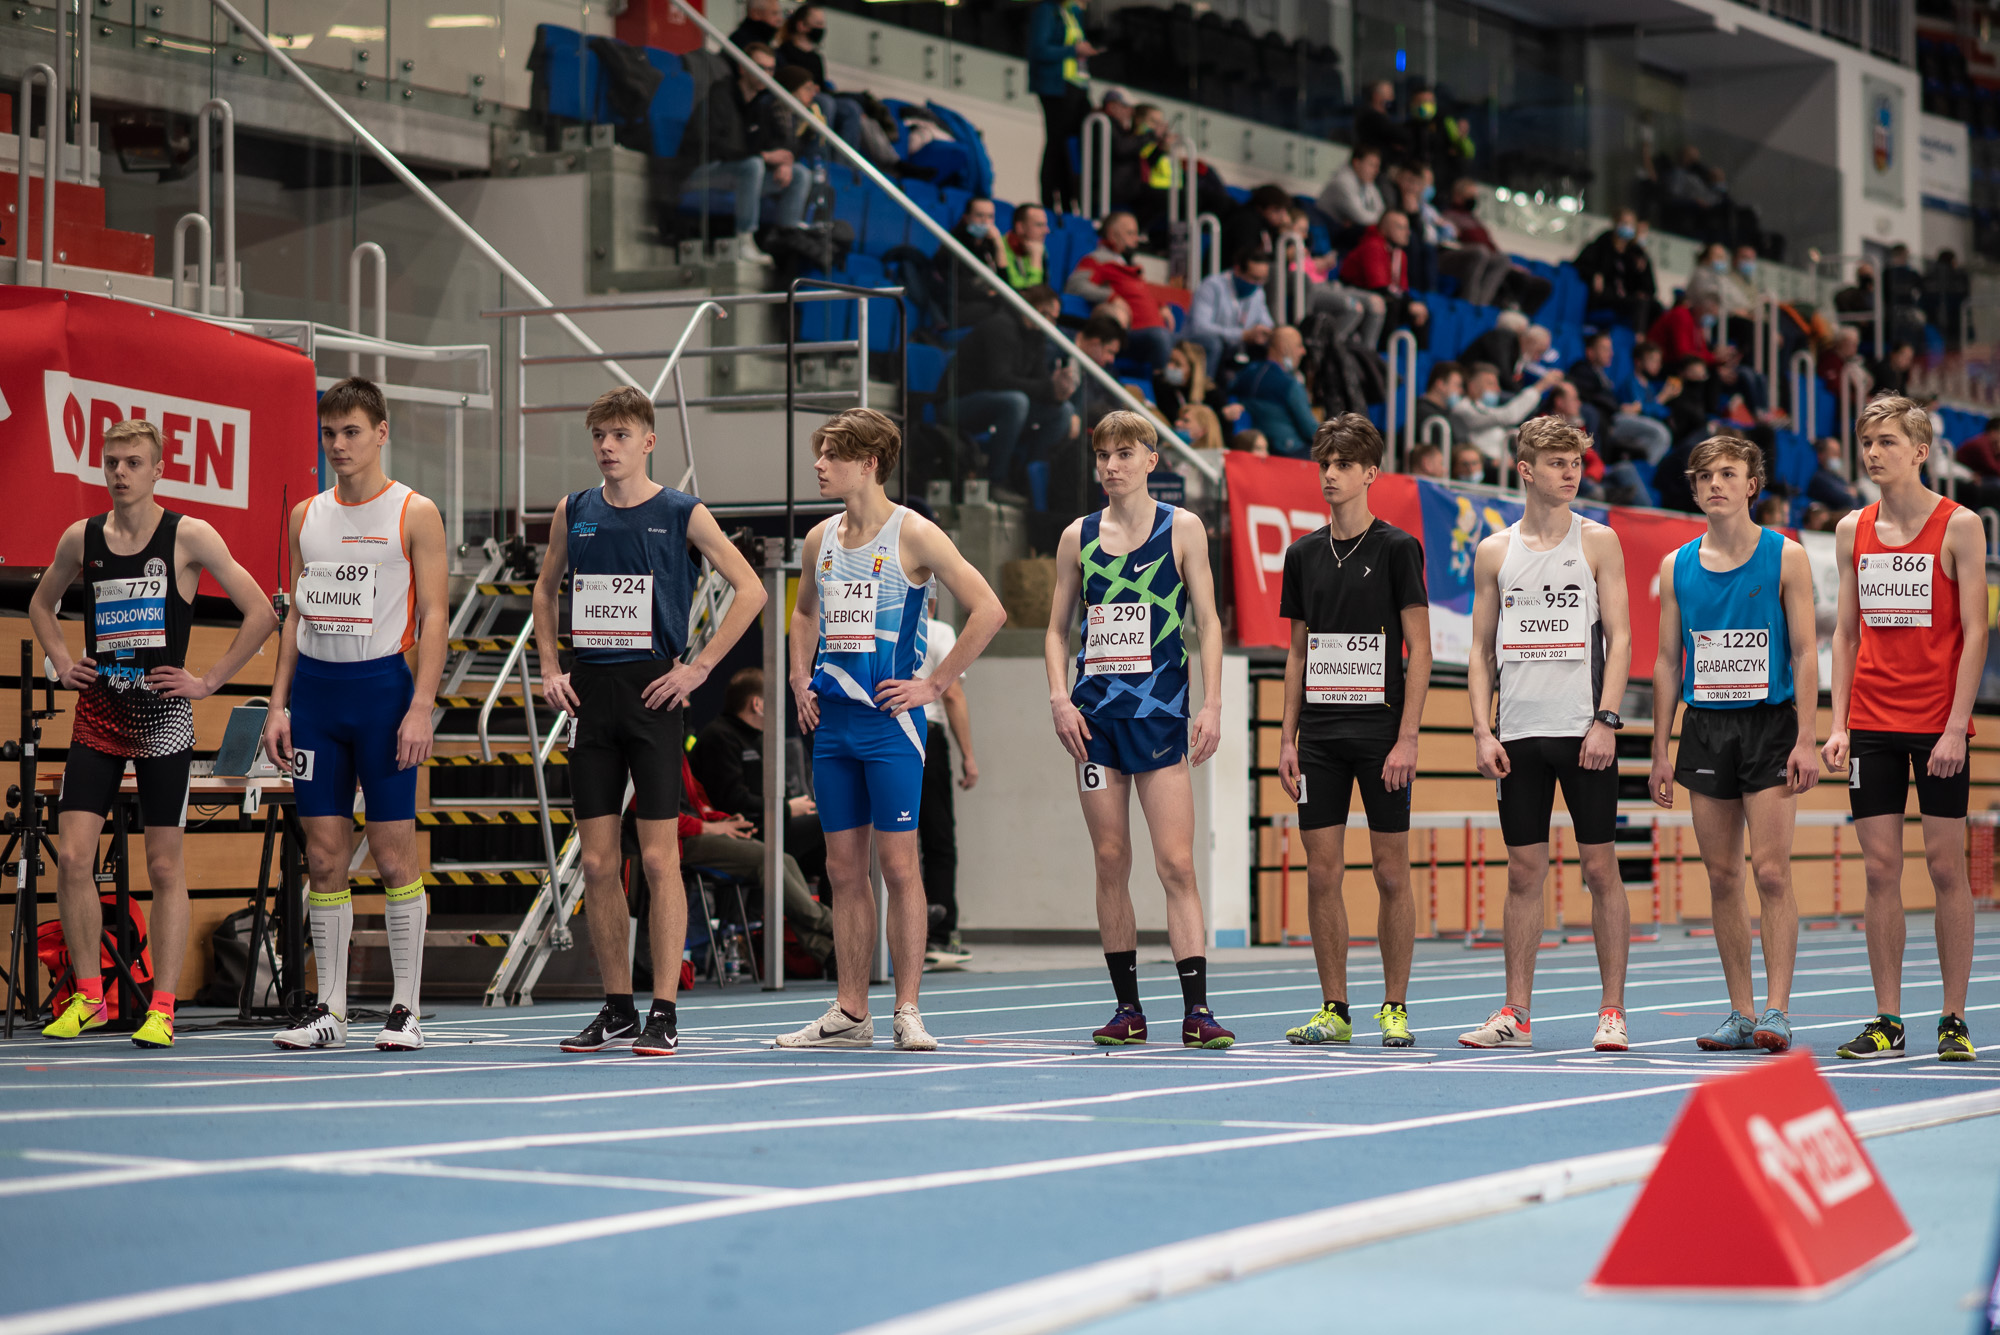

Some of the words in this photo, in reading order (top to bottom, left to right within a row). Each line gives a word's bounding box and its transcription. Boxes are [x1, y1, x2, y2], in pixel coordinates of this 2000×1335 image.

[63, 392, 235, 490] OREN
[1892, 555, 1928, 572] 866
[310, 569, 333, 578] TORUŃ
[335, 565, 369, 582] 689
[101, 587, 123, 597] TORUŃ
[126, 580, 161, 598] 779
[585, 583, 608, 591] TORUŃ
[612, 577, 646, 595] 924
[843, 583, 874, 599] 741
[1860, 583, 1929, 597] MACHULEC
[306, 591, 362, 606] KLIMIUK
[1516, 598, 1541, 606] TORUŃ
[1545, 592, 1580, 609] 952
[96, 607, 164, 626] WESOŁOWSKI
[585, 605, 638, 619] HERZYK
[825, 610, 873, 623] HLEBICKI
[1113, 605, 1146, 622] 290
[1870, 614, 1892, 624] TORUŃ
[1894, 616, 1914, 624] 2021
[310, 622, 334, 632] TORUŃ
[336, 624, 354, 632] 2021
[1520, 619, 1569, 632] SZWED
[108, 638, 131, 649] TORUŃ
[133, 638, 150, 647] 2021
[587, 636, 612, 646] TORUŃ
[615, 638, 633, 646] 2021
[826, 640, 841, 650] ORUŃ
[843, 642, 861, 650] 2021
[1090, 632, 1144, 647] GANCARZ
[1321, 641, 1343, 649] TORUŃ
[1346, 636, 1380, 652] 654
[1723, 632, 1768, 648] 1220
[1520, 649, 1547, 659] TORUŃ
[1549, 650, 1567, 658] 2021
[1096, 662, 1116, 672] TORUŃ
[1309, 662, 1382, 675] KORNASIEWICZ
[1696, 659, 1766, 673] GRABARCZYK
[1321, 692, 1347, 701] TORUŃ
[1707, 690, 1730, 699] TORUŃ
[1732, 691, 1751, 699] 2021
[1084, 764, 1100, 788] 6
[250, 788, 257, 812] 1
